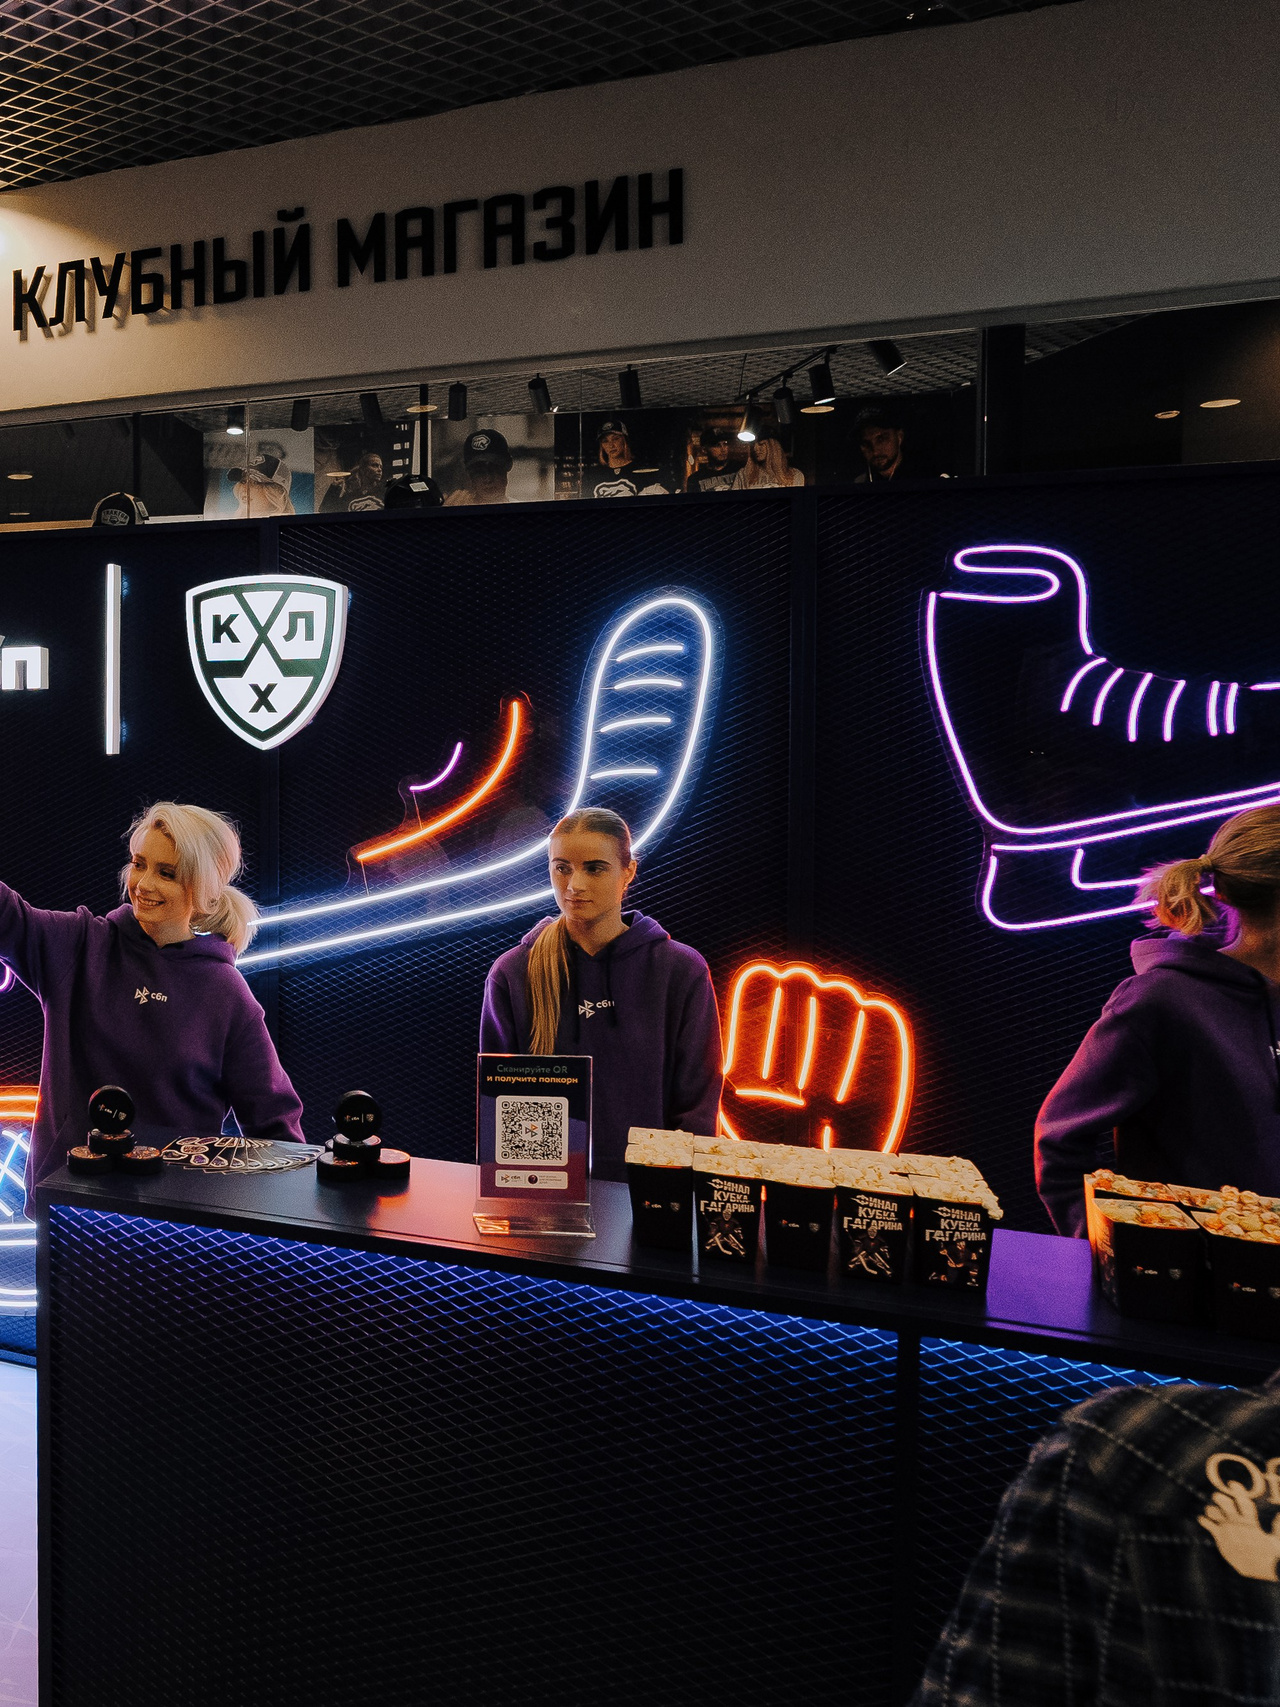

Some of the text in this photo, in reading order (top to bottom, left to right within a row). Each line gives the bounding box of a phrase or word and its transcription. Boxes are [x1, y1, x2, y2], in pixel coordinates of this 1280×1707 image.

[12, 168, 683, 331] КЛУБНЫЙ МАГАЗИН
[150, 992, 168, 1003] сбп
[496, 1063, 568, 1075] Сканируйте QR
[494, 1075, 537, 1084] получите
[538, 1076, 579, 1085] попкорн
[706, 1178, 751, 1195] ФИНАЛ
[713, 1189, 751, 1203] КУБКА
[850, 1194, 898, 1212] ФИНАЛ
[699, 1200, 755, 1213] ГАГАРИНА
[858, 1206, 899, 1221] КУБКА
[931, 1206, 981, 1222] ФИНАЛ
[843, 1216, 903, 1231] ГАГАРИНА
[940, 1218, 982, 1231] КУБКА
[925, 1229, 987, 1242] ГАГАРИНА
